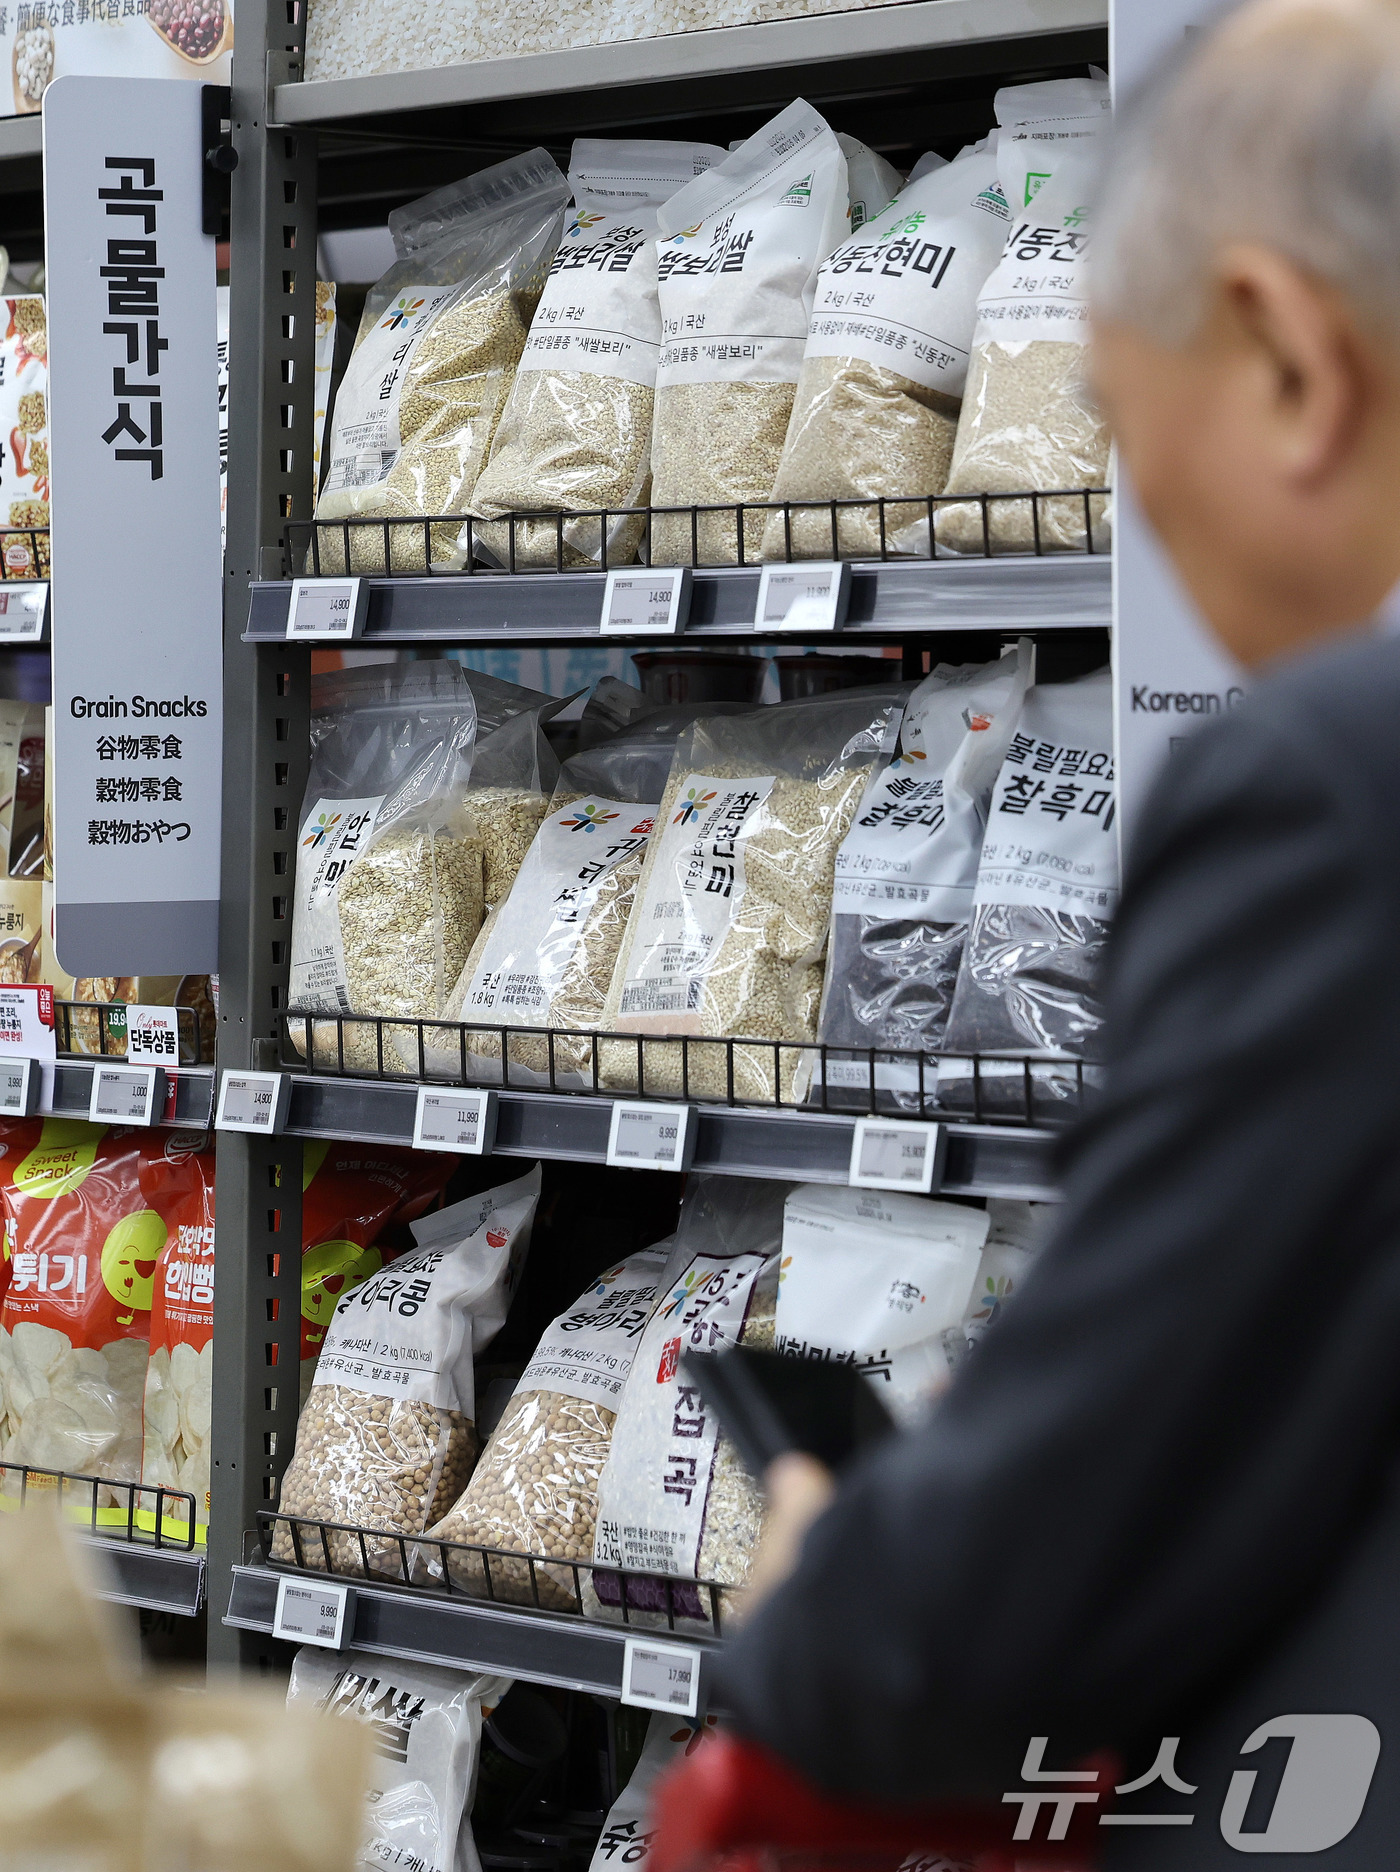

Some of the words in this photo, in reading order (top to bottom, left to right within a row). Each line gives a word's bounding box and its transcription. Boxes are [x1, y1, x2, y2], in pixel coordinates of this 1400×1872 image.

[852, 291, 875, 308] 국산
[98, 157, 168, 481] 곡물간식
[565, 306, 585, 320] 국산
[686, 314, 706, 330] 국산
[330, 599, 350, 611] 14,900
[649, 591, 672, 603] 14,900
[71, 694, 128, 718] Grain
[131, 694, 207, 718] Snacks
[1131, 685, 1220, 714] Korean
[96, 734, 183, 760] 谷物零食
[96, 776, 183, 803] 穀物零食
[999, 774, 1115, 832] 찰흑미
[88, 819, 191, 845] 穀物おやつ
[471, 991, 484, 1005] 1.8
[483, 992, 495, 1008] kg
[130, 1028, 176, 1055] 단독상품
[132, 1086, 148, 1097] 1,000
[254, 1092, 272, 1104] 14,900
[457, 1110, 479, 1123] 11,990
[31, 1150, 79, 1168] Sweet
[24, 1166, 74, 1180] Snack
[23, 1302, 39, 1313] 스낵
[380, 1344, 389, 1356] 2
[389, 1345, 398, 1361] kg
[605, 1354, 618, 1370] kg
[602, 1520, 619, 1545] 국산
[609, 1542, 623, 1567] kg
[320, 1605, 338, 1618] 9,990
